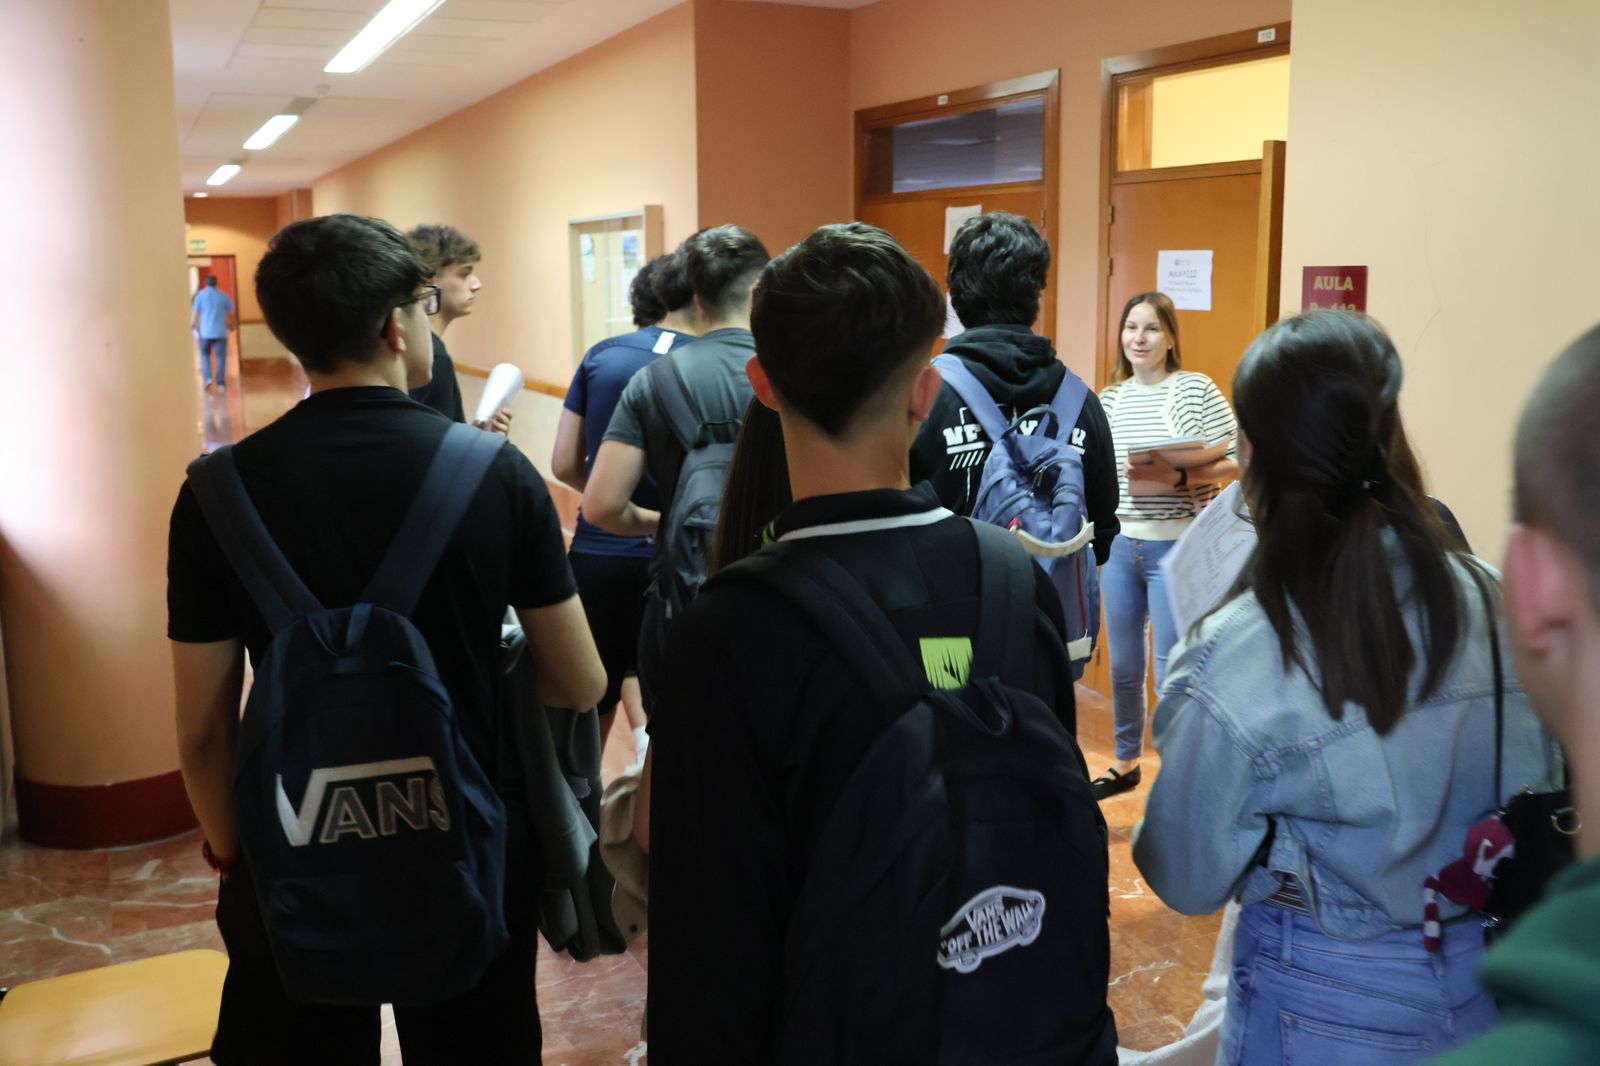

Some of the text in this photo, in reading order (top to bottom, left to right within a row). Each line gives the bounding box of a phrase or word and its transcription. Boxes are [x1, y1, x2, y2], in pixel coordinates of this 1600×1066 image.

[1313, 276, 1354, 290] AULA
[943, 422, 990, 447] NE
[275, 756, 451, 847] VANS
[976, 916, 1003, 948] THE
